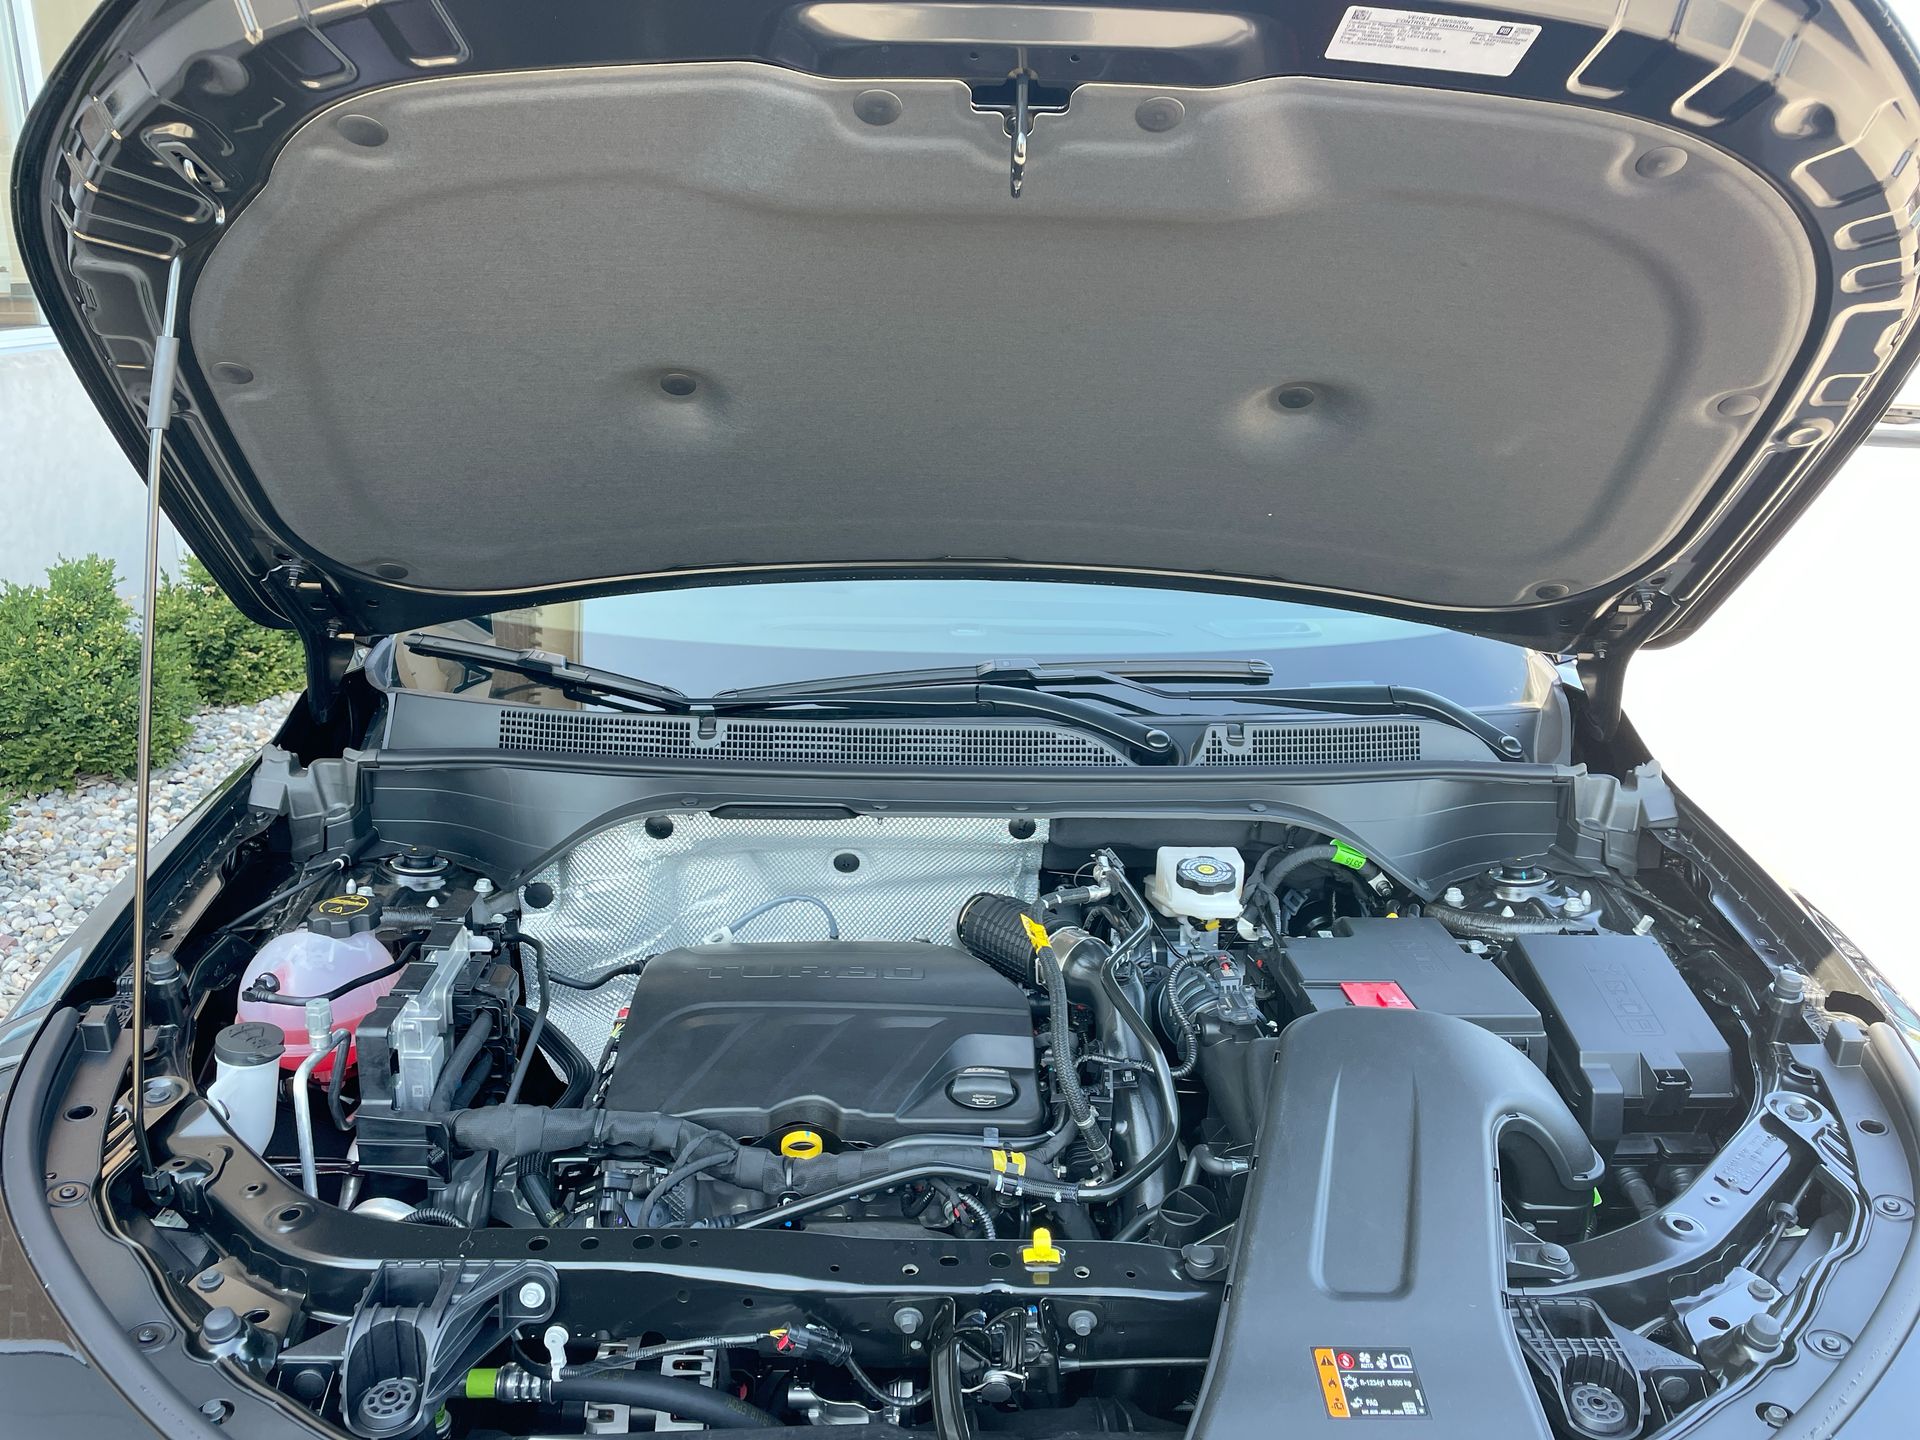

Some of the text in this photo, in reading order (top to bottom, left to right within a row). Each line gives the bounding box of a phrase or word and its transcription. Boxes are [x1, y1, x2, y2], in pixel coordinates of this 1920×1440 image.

[1396, 19, 1475, 31] CONTROL INFORMATION
[1407, 14, 1470, 25] VEHICLE EMISSION
[696, 965, 925, 980] TURBO
